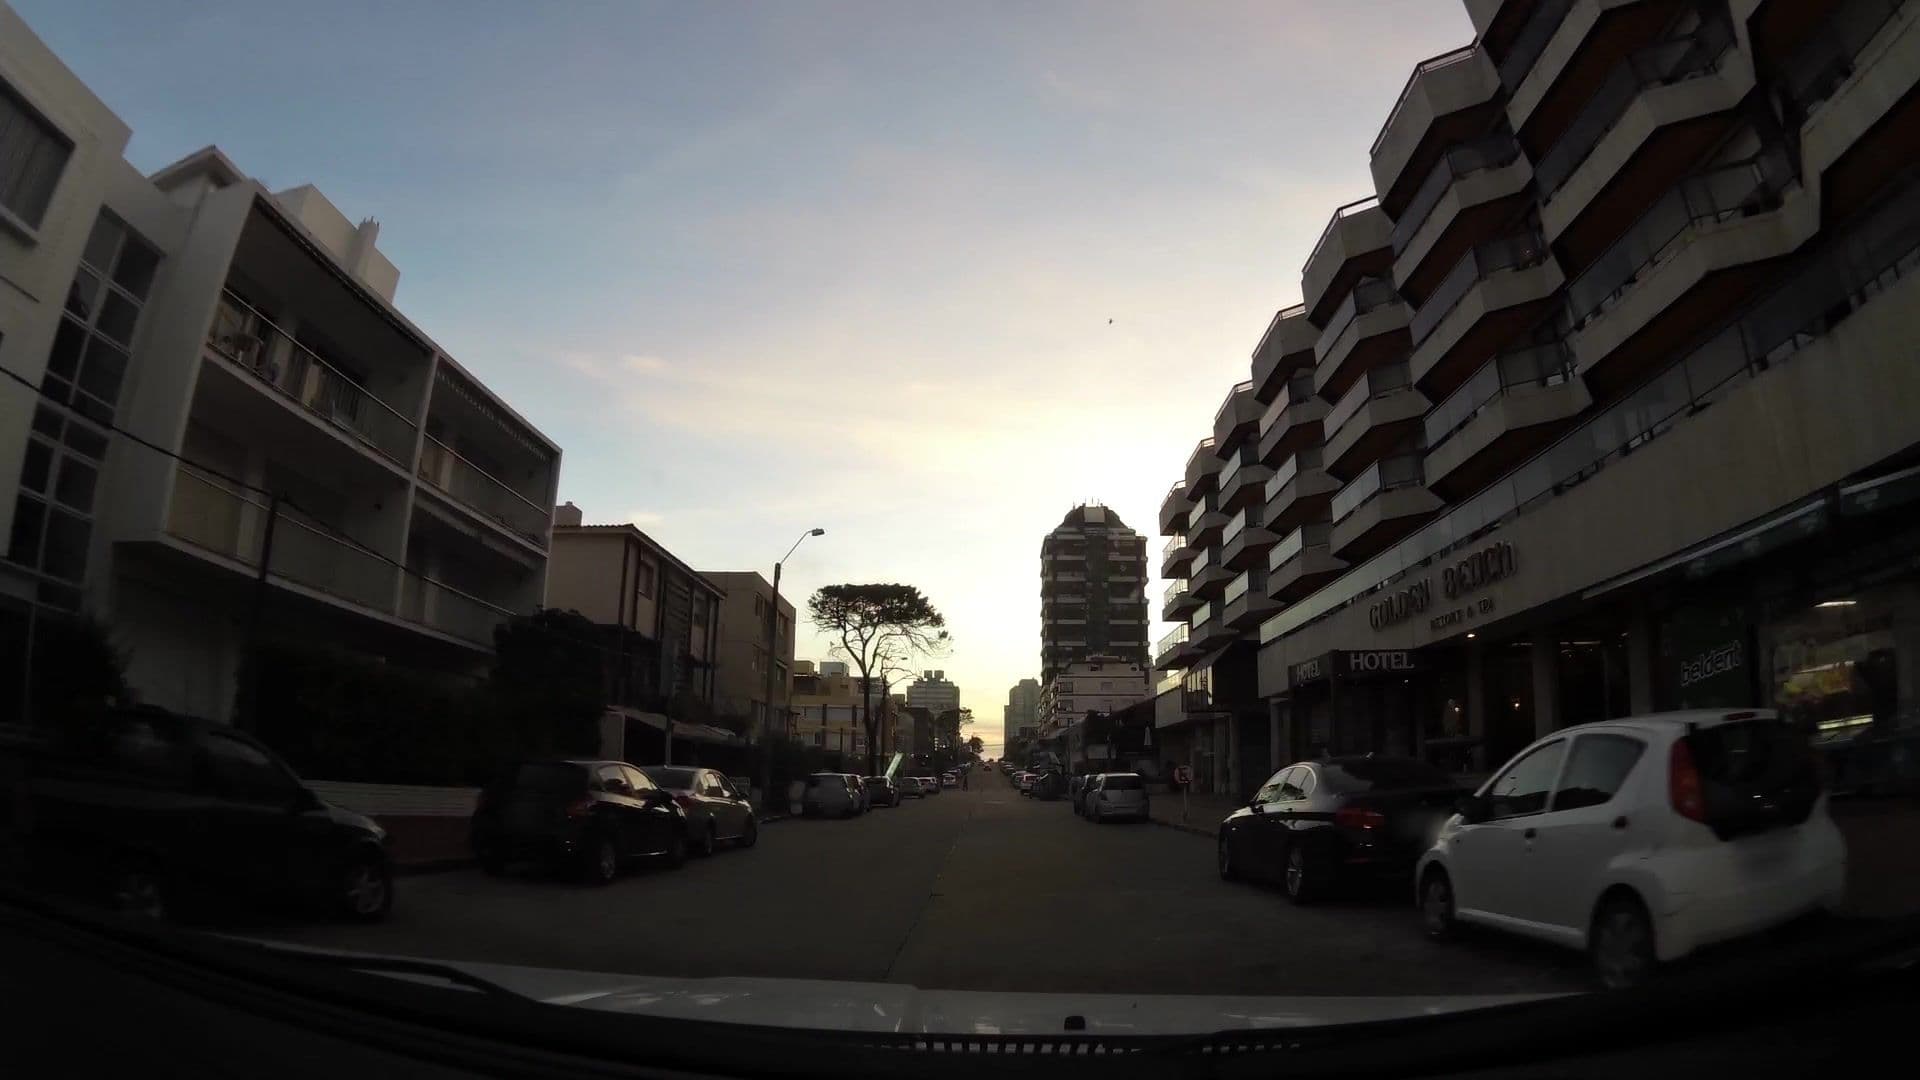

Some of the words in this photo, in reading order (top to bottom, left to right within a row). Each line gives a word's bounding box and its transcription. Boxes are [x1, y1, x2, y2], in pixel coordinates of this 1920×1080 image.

[1369, 578, 1430, 631] GOLDEN
[1444, 541, 1515, 598] BEACH
[1296, 660, 1320, 683] HOTEL
[1350, 652, 1416, 672] HOTEL
[1680, 640, 1744, 687] beldent
